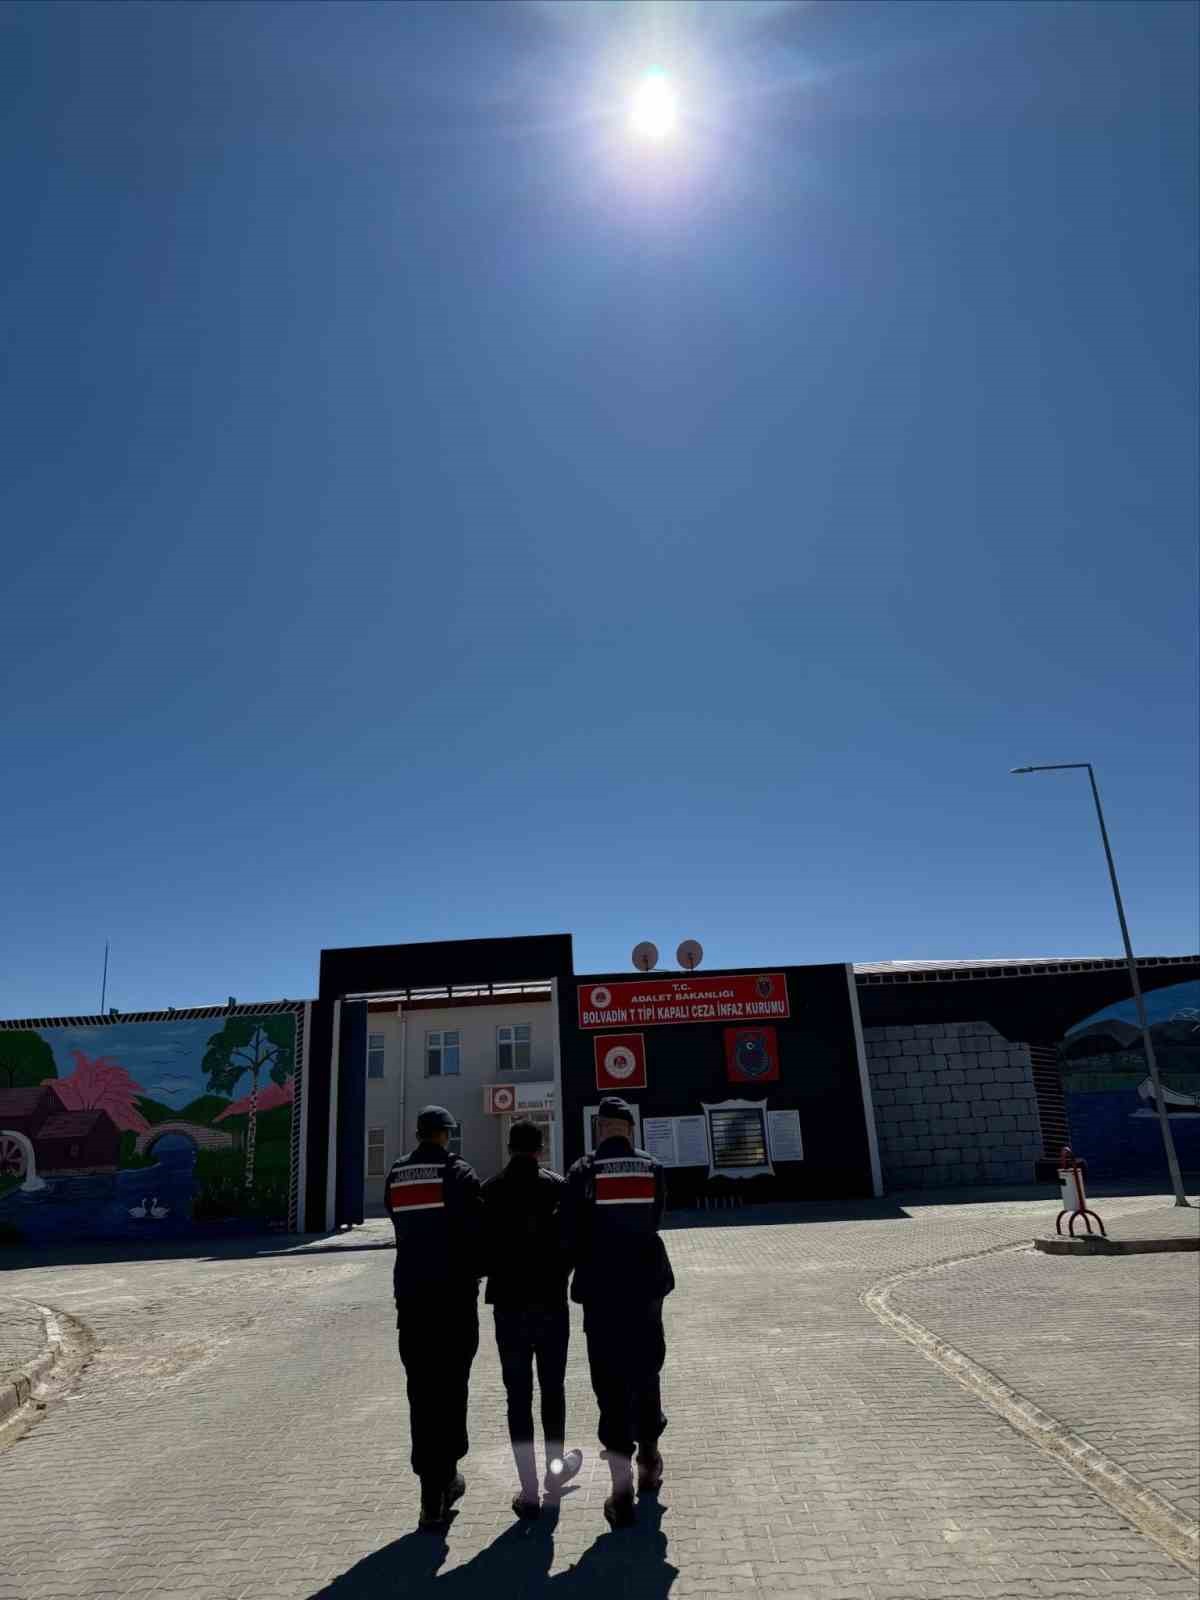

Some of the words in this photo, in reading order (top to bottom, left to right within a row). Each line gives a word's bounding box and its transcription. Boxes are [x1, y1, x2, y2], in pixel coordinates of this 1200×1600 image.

[631, 994, 672, 1003] ADALET
[630, 1008, 636, 1021] T
[657, 1005, 689, 1020] KAPALI
[745, 1000, 785, 1016] KURUMU
